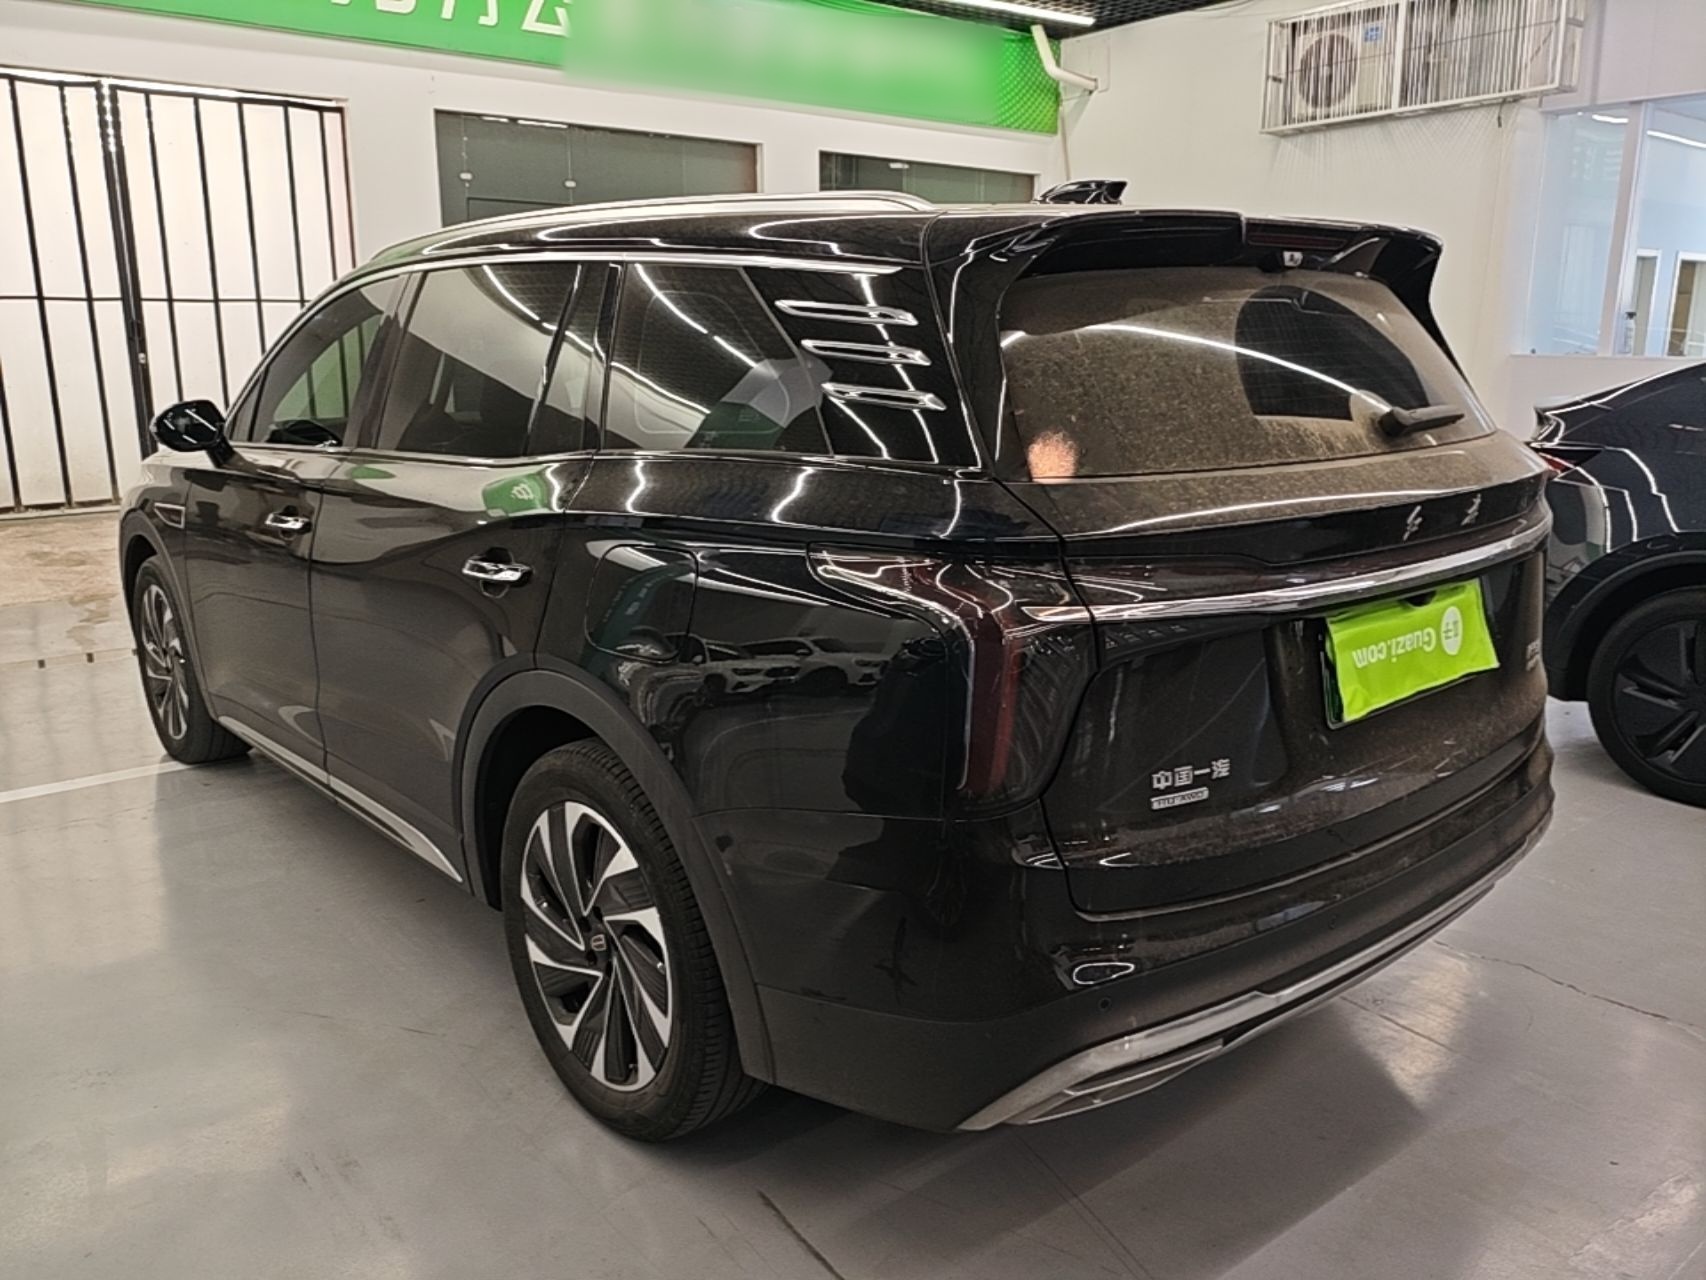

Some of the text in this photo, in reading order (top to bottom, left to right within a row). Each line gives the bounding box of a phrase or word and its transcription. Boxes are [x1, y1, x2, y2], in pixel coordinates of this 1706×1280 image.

[1352, 627, 1436, 668] Guazi.com
[1151, 758, 1231, 790] 中国一汽
